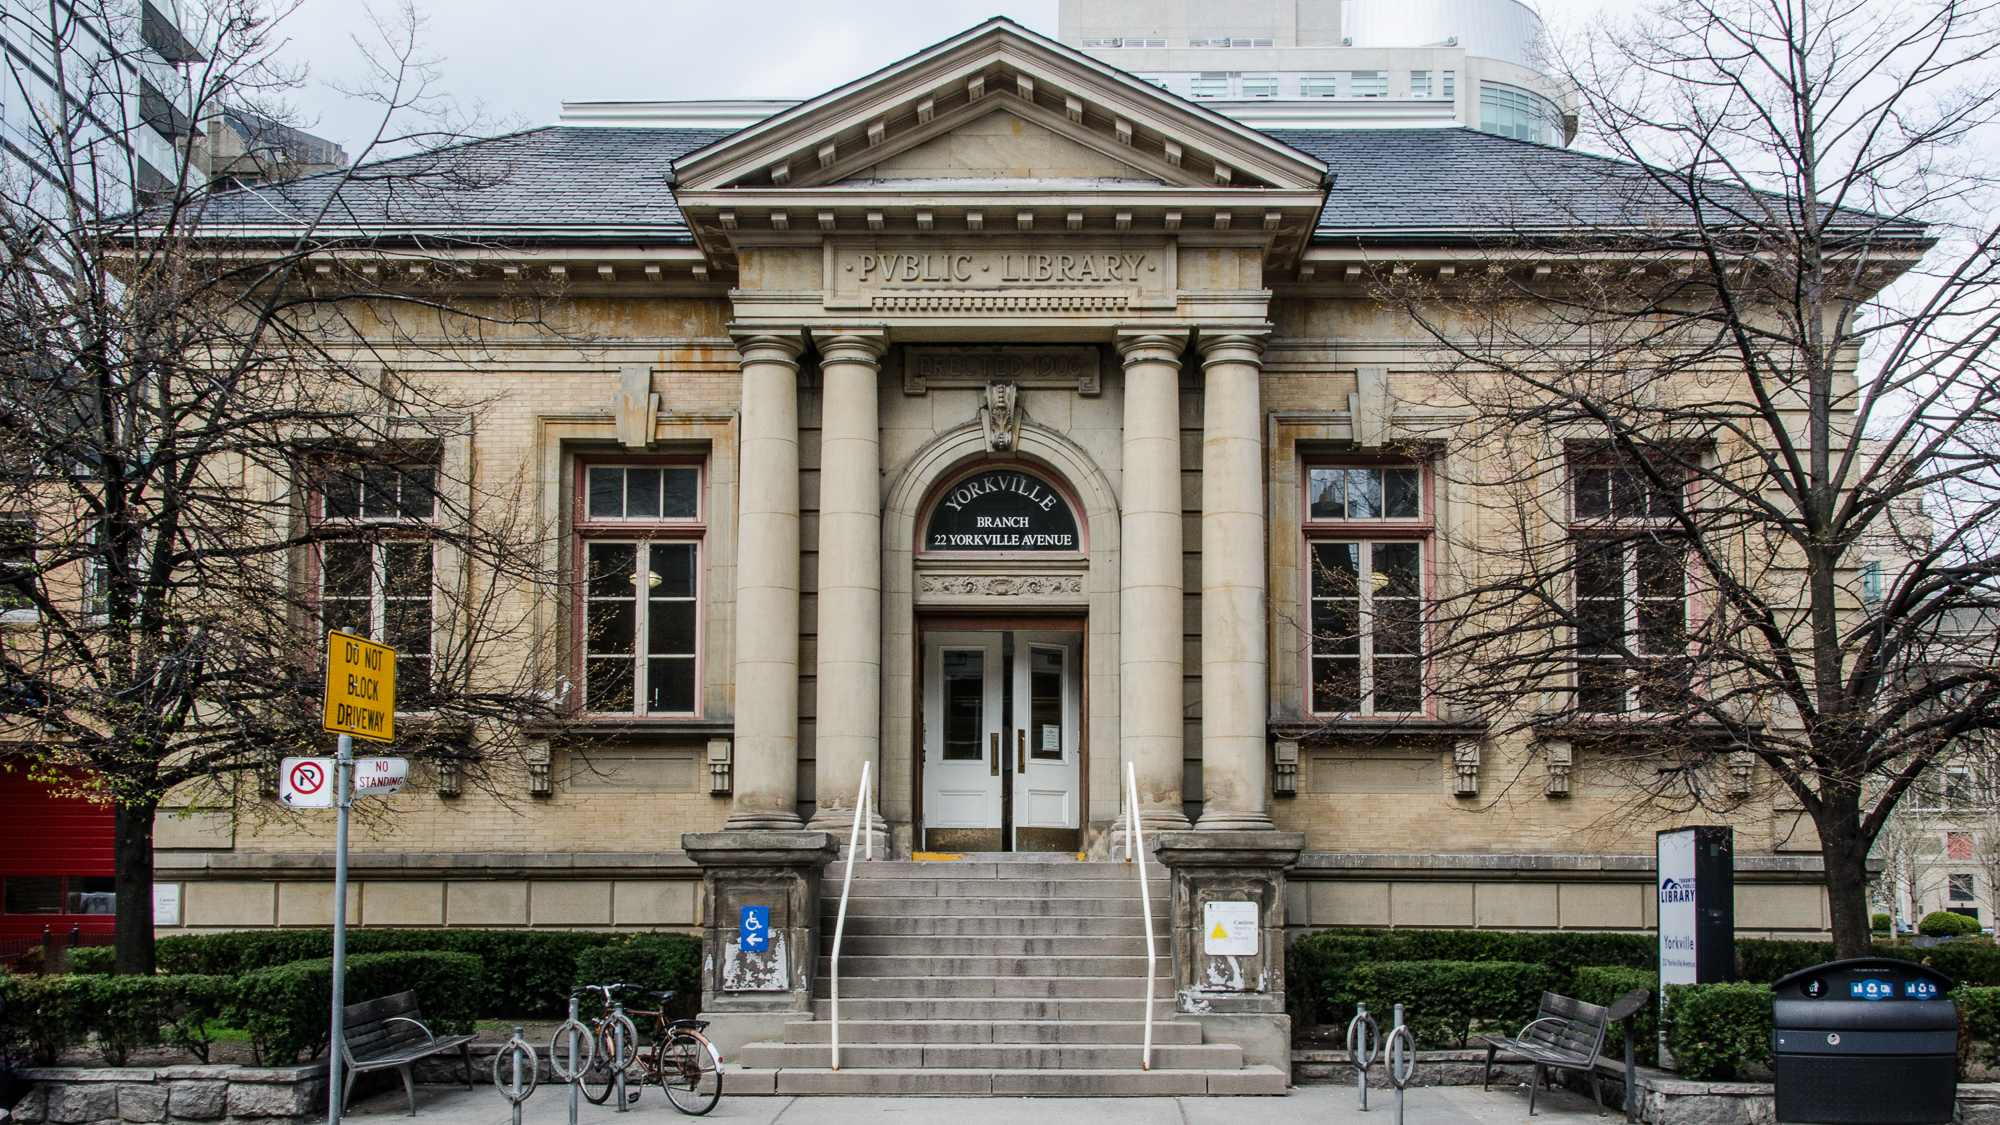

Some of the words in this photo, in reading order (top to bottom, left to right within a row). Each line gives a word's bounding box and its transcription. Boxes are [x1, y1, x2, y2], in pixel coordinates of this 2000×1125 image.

[859, 254, 972, 281] PVBLIC
[1001, 254, 1145, 282] LIBRARY
[919, 355, 1023, 376] ERECTED
[1034, 355, 1082, 376] 1906
[945, 475, 1056, 511] YORKVILLE
[977, 516, 1029, 528] BRANCH
[934, 534, 947, 545] 22
[949, 534, 1020, 546] YORKVILLE
[1021, 534, 1072, 546] AVENUE
[345, 641, 359, 666] DO
[364, 646, 383, 672] NOT
[347, 673, 379, 702] BLOCK
[337, 703, 385, 733] DRIVEWAY
[375, 760, 389, 773] NO
[359, 776, 404, 788] STANDING
[1661, 889, 1695, 903] LIBRARY
[1664, 935, 1694, 950] Yorkville
